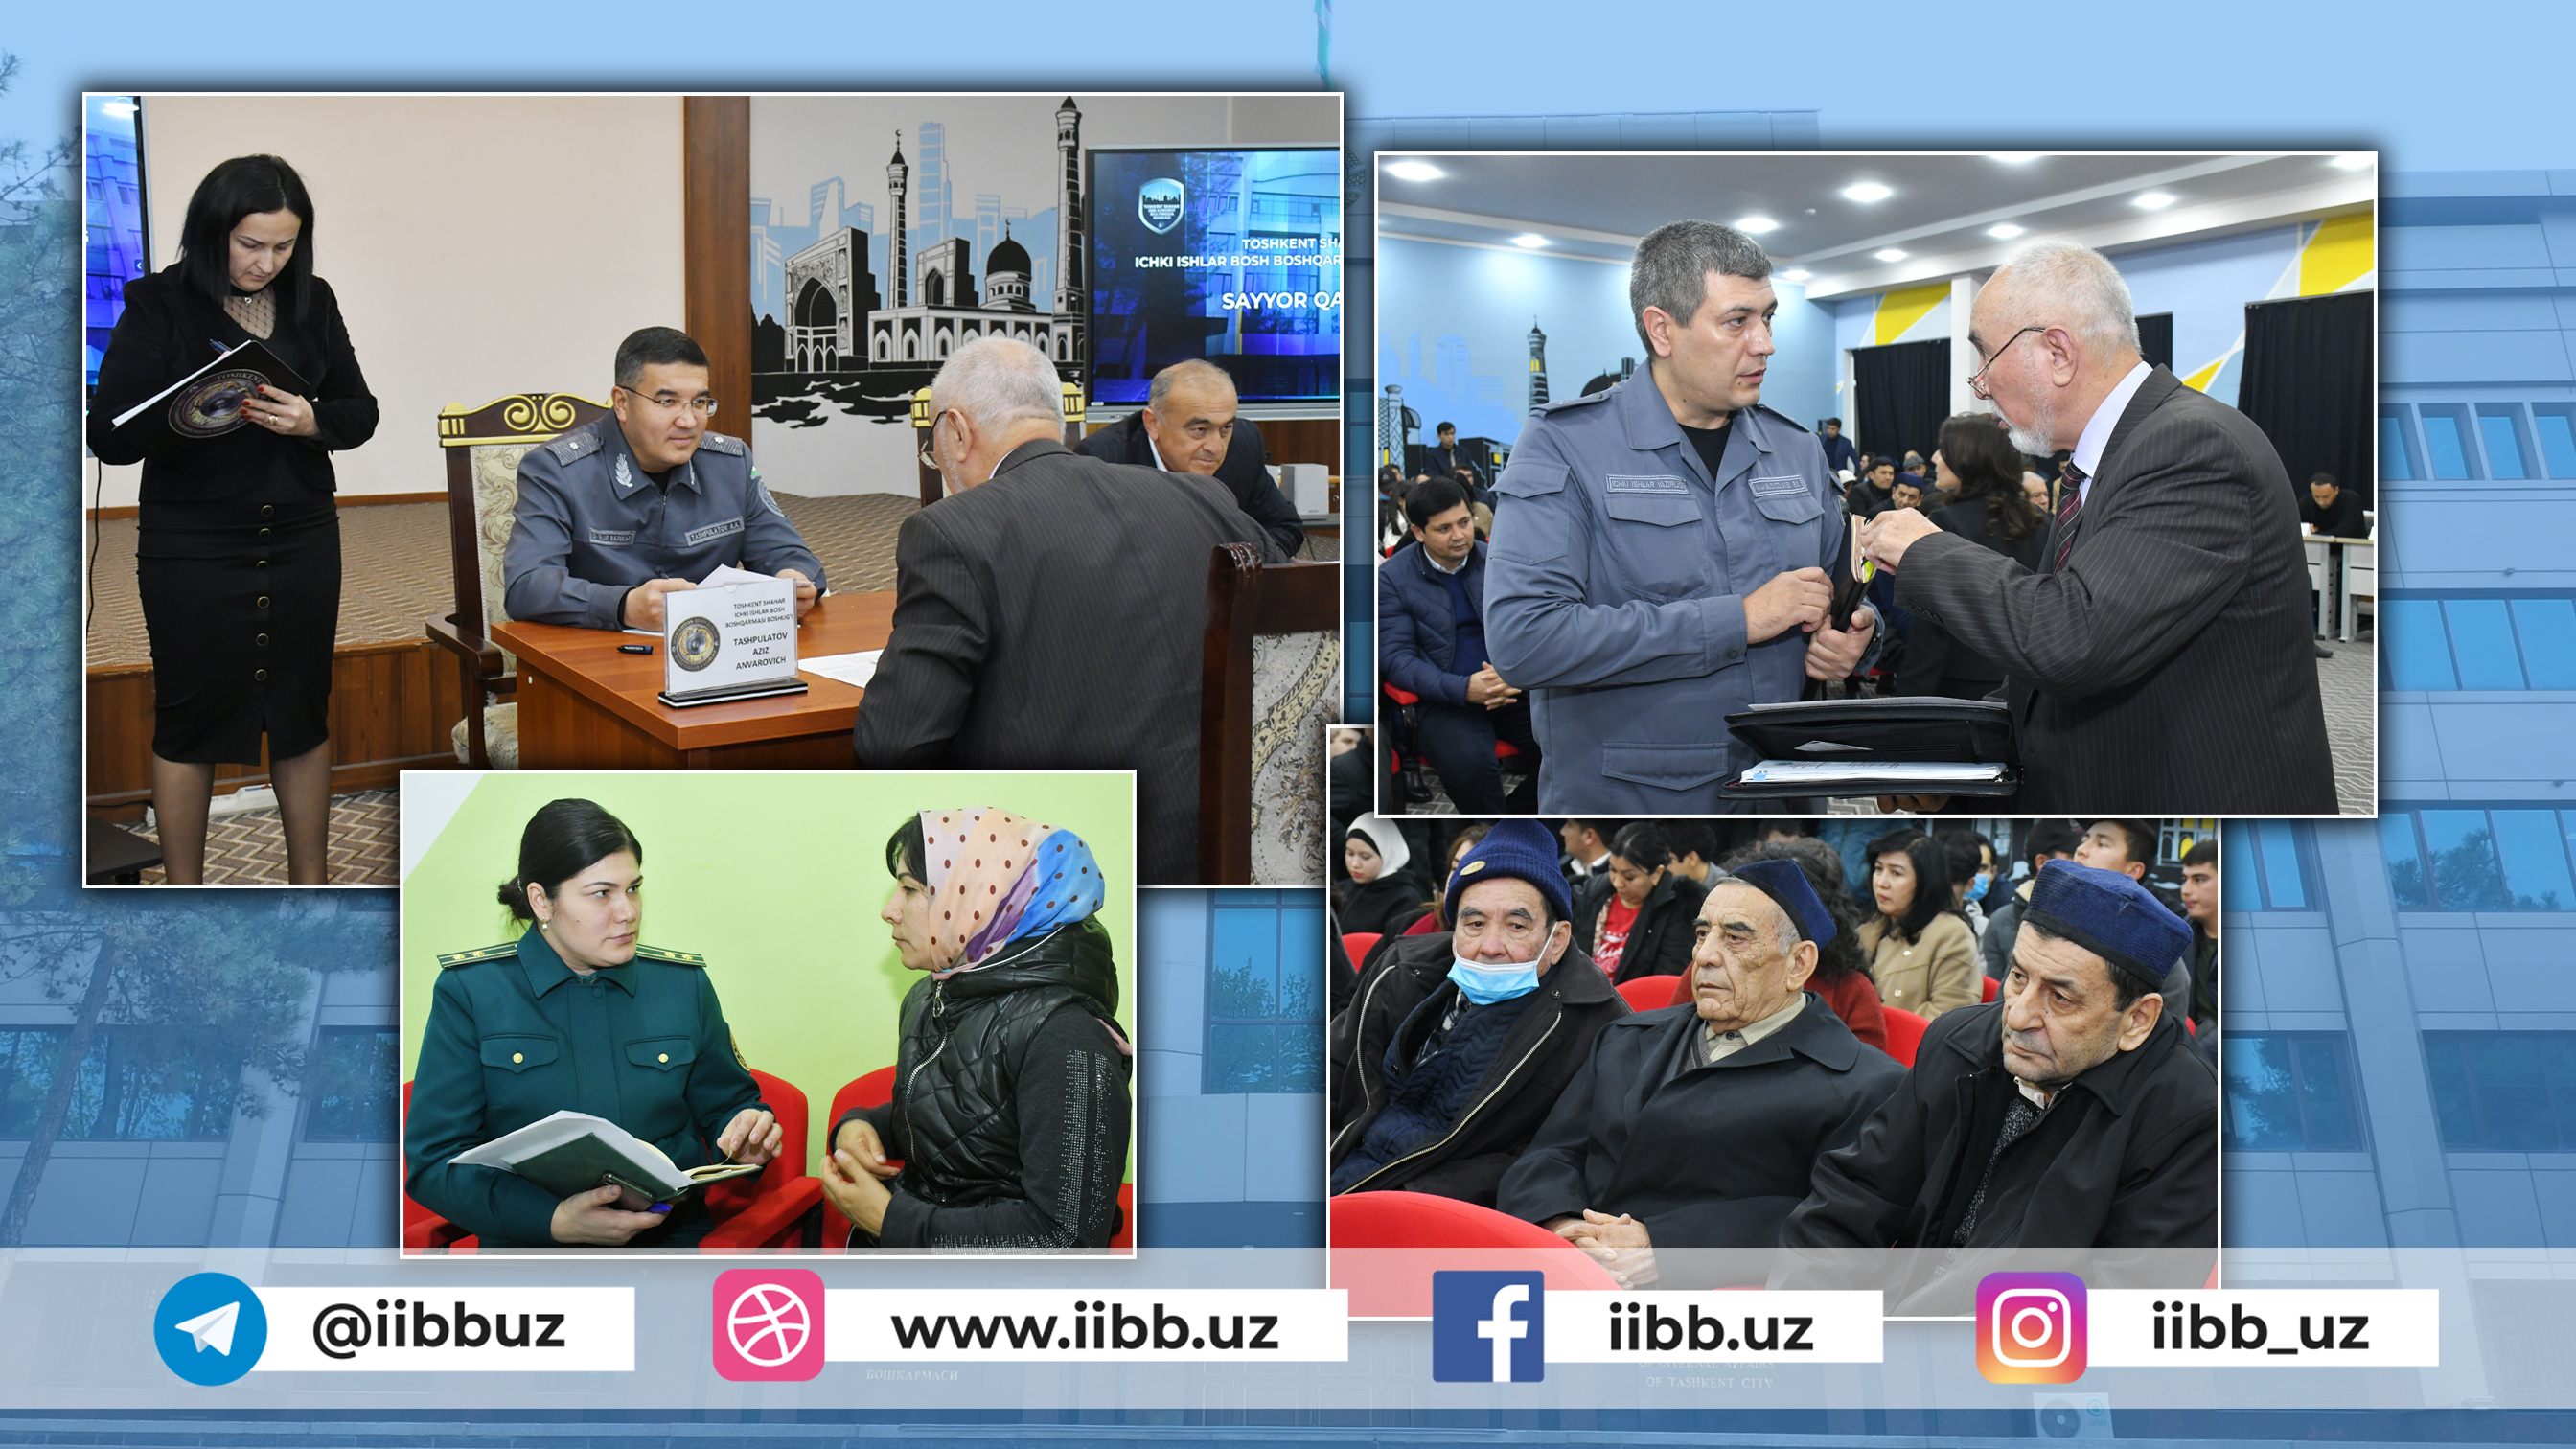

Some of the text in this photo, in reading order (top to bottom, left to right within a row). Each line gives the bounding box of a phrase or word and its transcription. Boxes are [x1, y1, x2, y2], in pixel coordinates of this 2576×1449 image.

[1242, 239, 1316, 249] TOSHKENT
[1135, 254, 1340, 268] ICHKI ISHLAR BOSH BOSHQAR
[1222, 291, 1308, 310] SAYYOR
[733, 600, 762, 610] TOSHKENT
[725, 617, 766, 628] BOSHQARMASI
[733, 632, 788, 646] TASHPULATOV
[752, 646, 770, 656] AZIZ
[735, 656, 787, 671] ANVAROVICH
[1645, 1376, 1774, 1389] OF TASHKENT CITY
